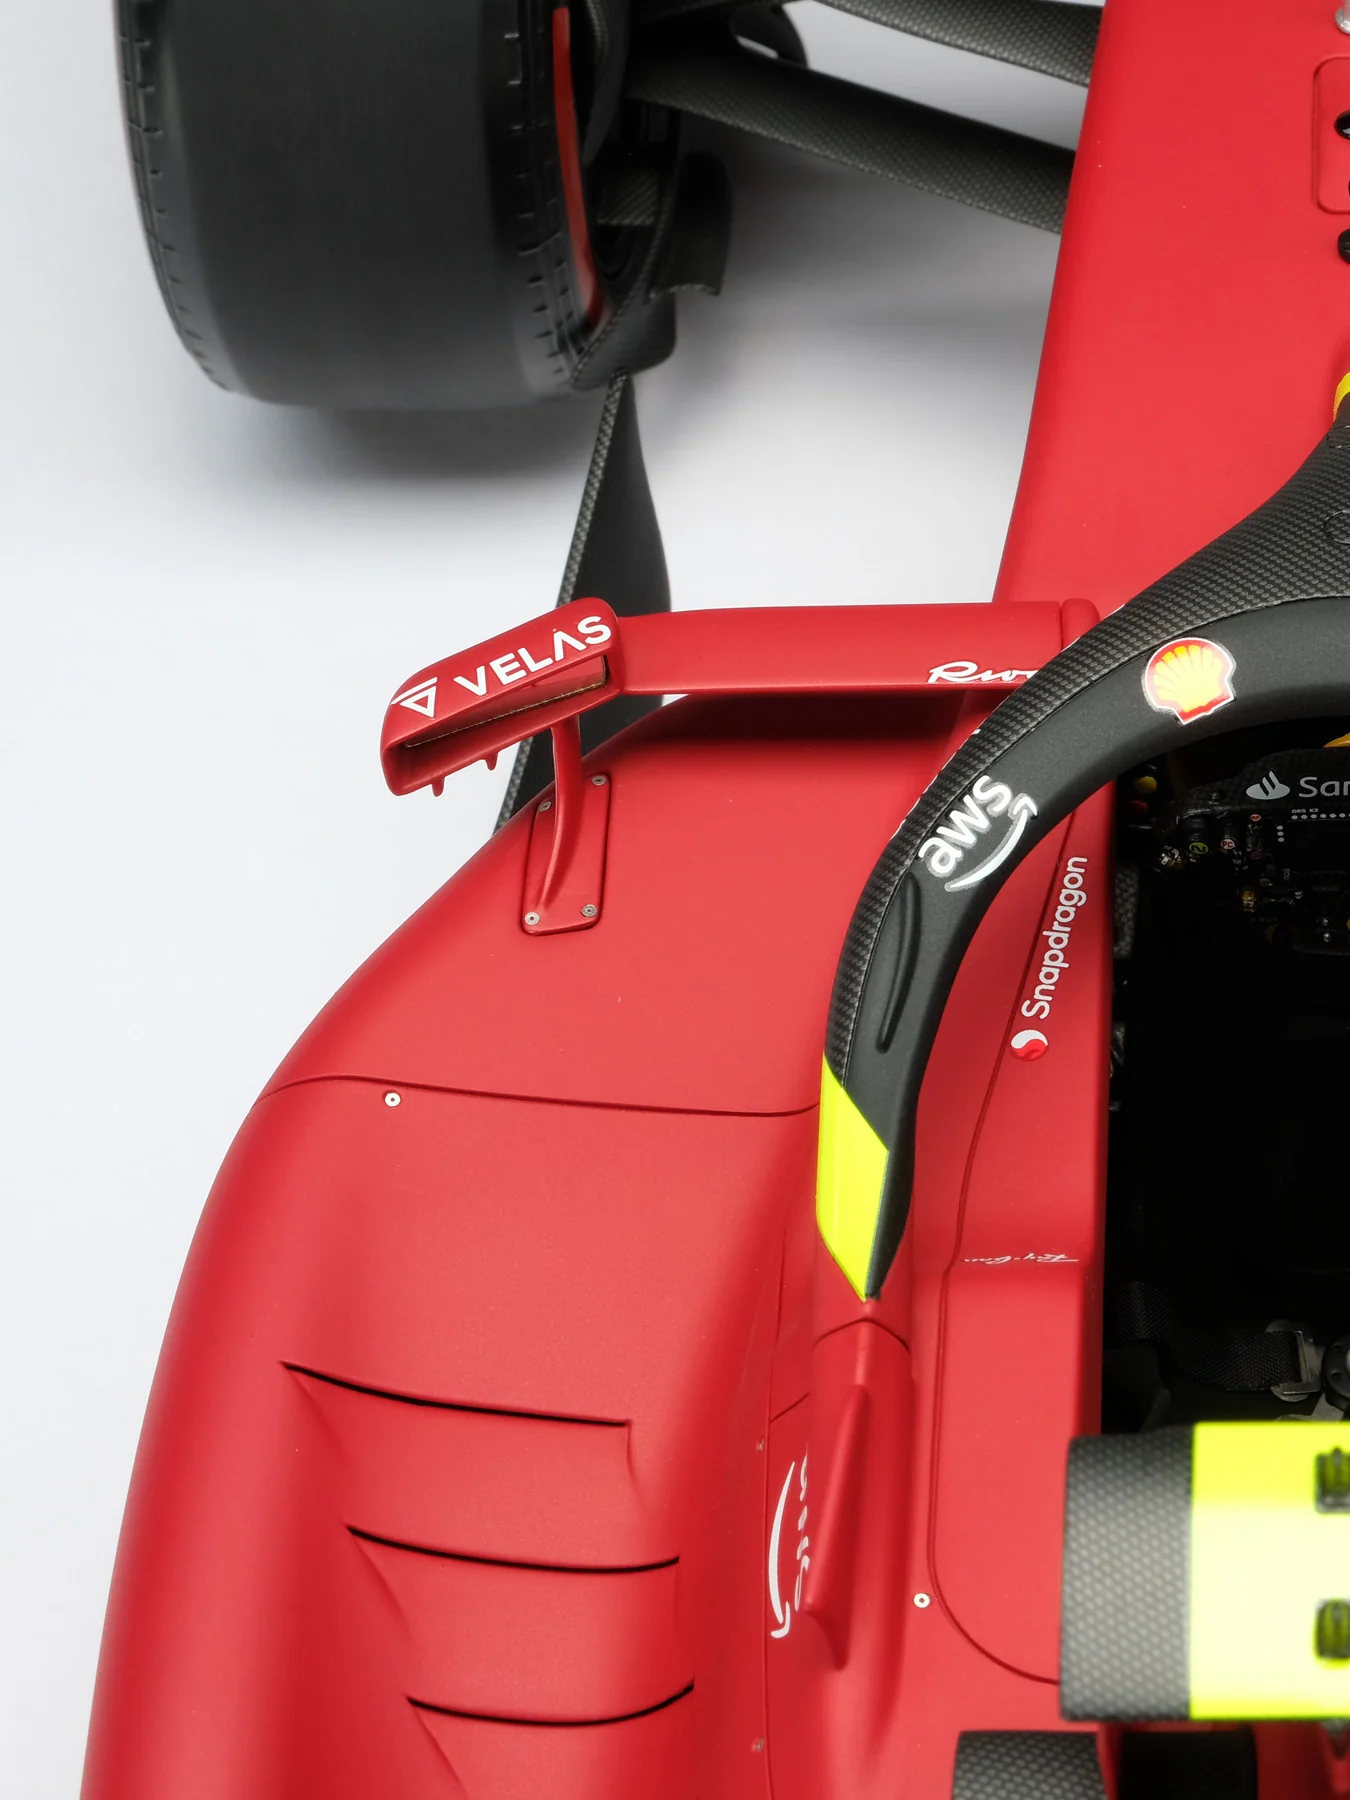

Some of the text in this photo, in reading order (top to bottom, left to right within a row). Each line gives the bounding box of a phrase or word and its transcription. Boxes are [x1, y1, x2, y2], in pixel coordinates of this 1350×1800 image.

[453, 615, 612, 697] VELAS
[927, 661, 1039, 684] Riv
[918, 775, 1012, 876] aws
[1021, 856, 1088, 1019] Snapdragon
